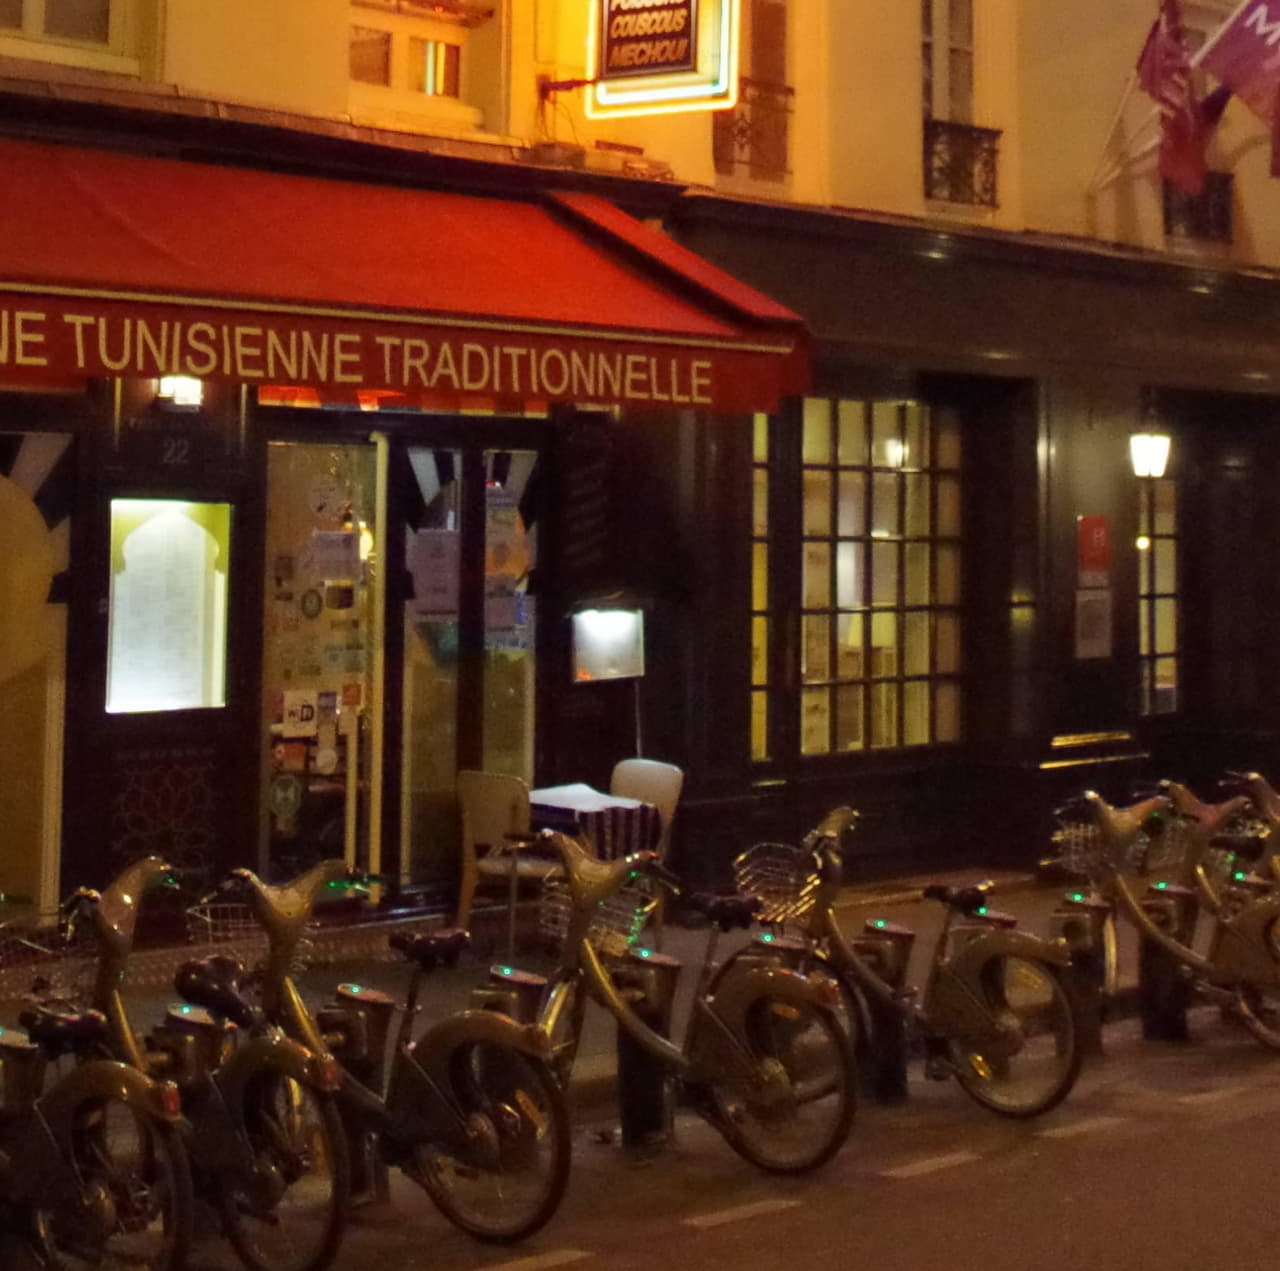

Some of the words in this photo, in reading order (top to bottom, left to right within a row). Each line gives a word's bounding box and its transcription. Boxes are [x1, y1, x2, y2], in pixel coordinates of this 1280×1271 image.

[611, 8, 687, 38] COUSCOUS
[608, 38, 687, 67] MECHOUI
[64, 314, 363, 384] TUNISIENNE
[375, 335, 712, 404] TRADITIONNELLE
[161, 439, 190, 464] 22
